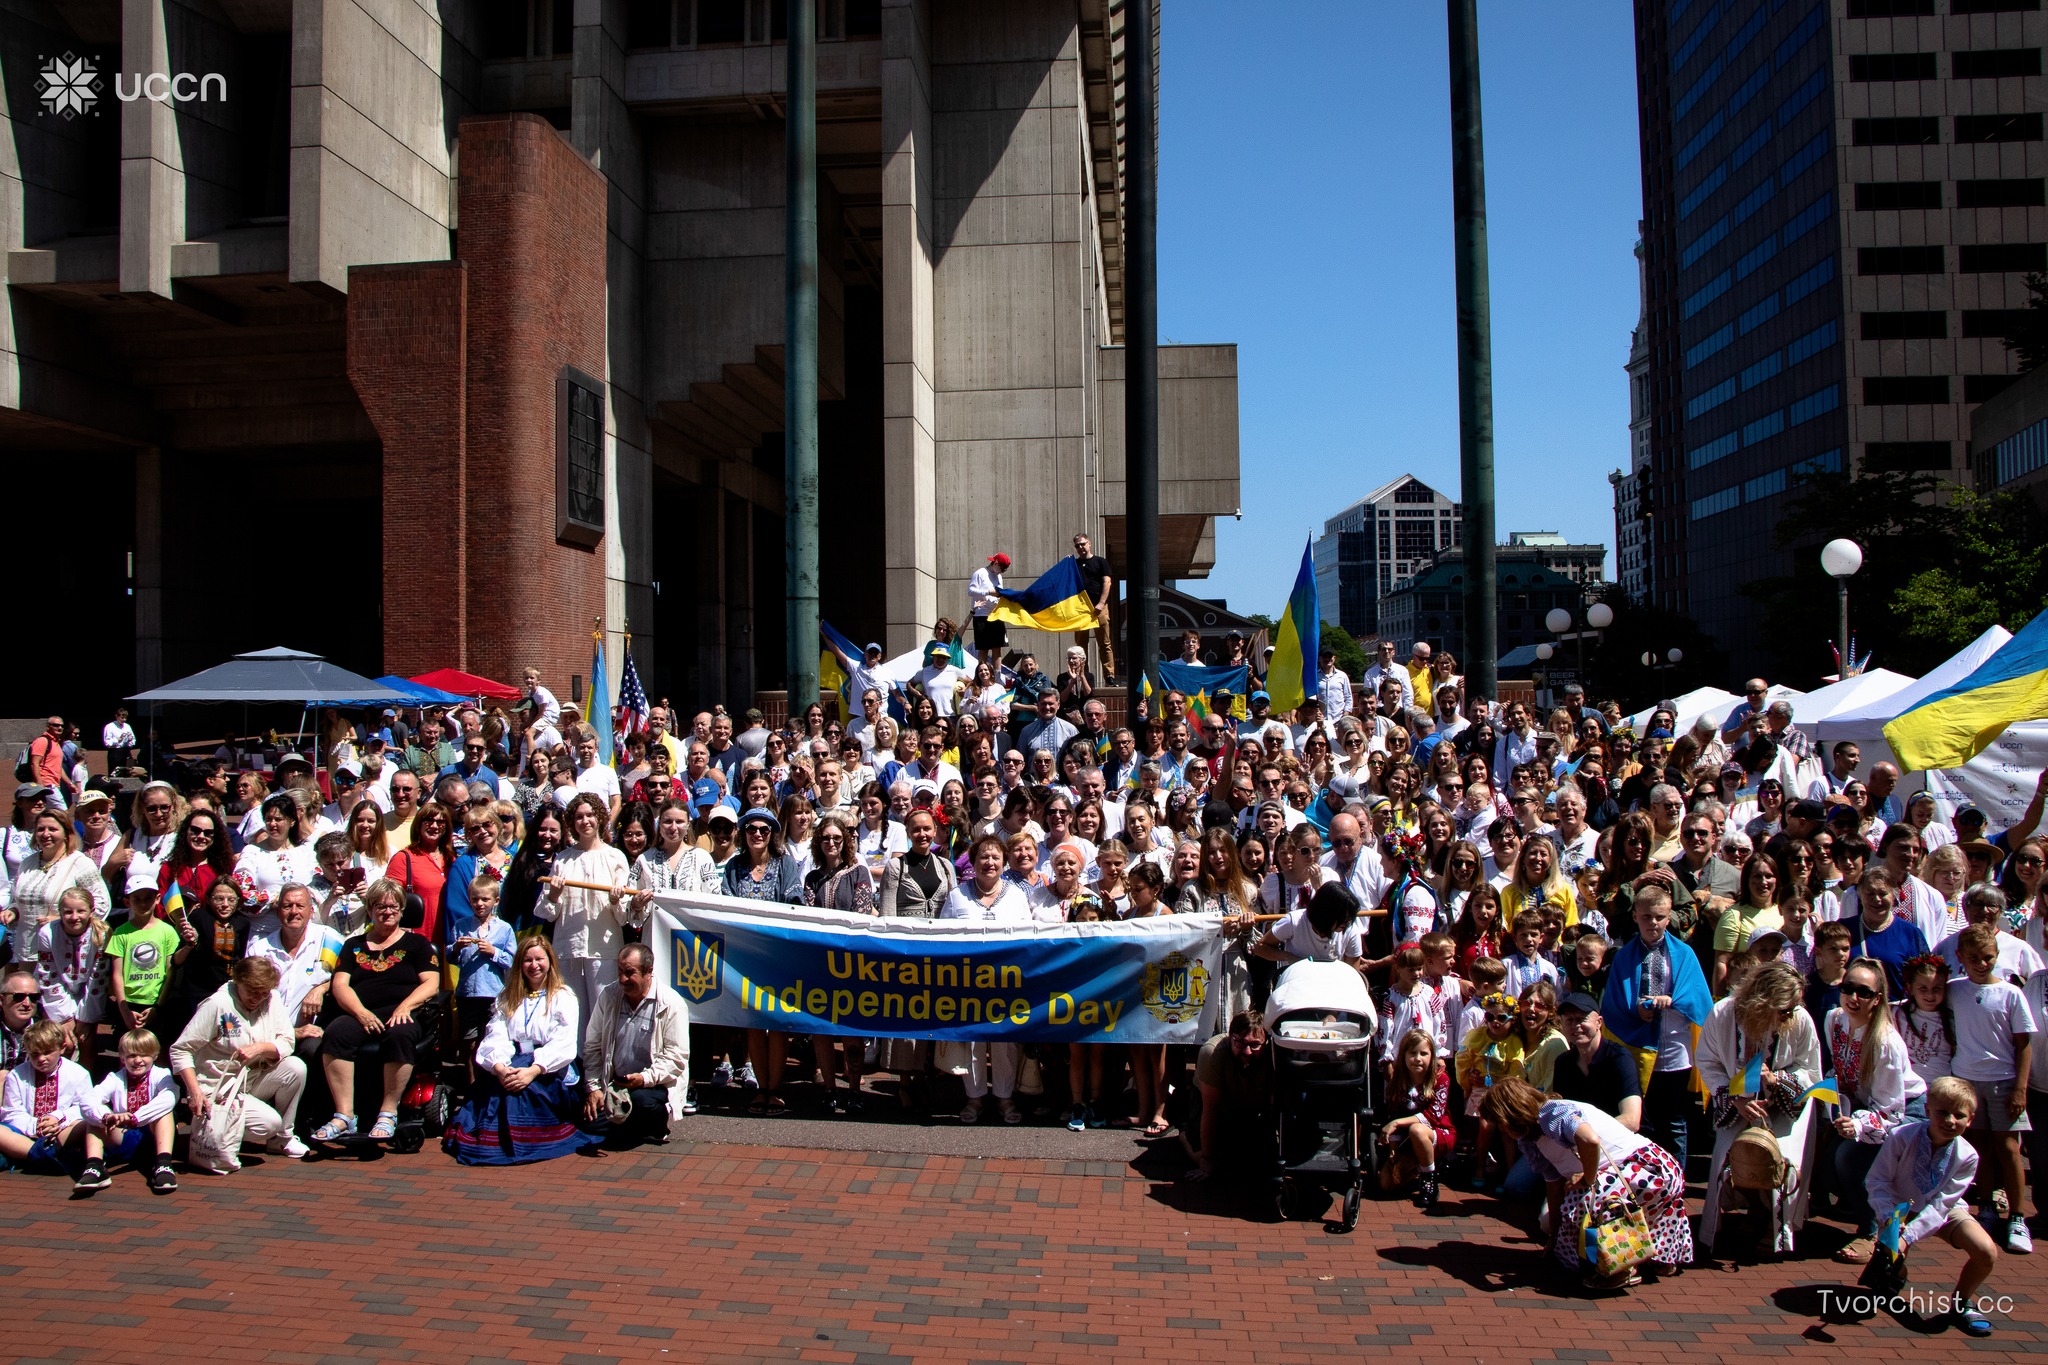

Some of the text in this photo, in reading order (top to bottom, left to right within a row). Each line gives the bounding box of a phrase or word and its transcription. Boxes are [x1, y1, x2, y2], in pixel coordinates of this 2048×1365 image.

[1549, 671, 1576, 679] BEER
[1549, 679, 1592, 687] GARDN
[826, 949, 1022, 989] Ukrainian
[129, 973, 143, 981] JUST
[741, 975, 1124, 1033] Independence Day
